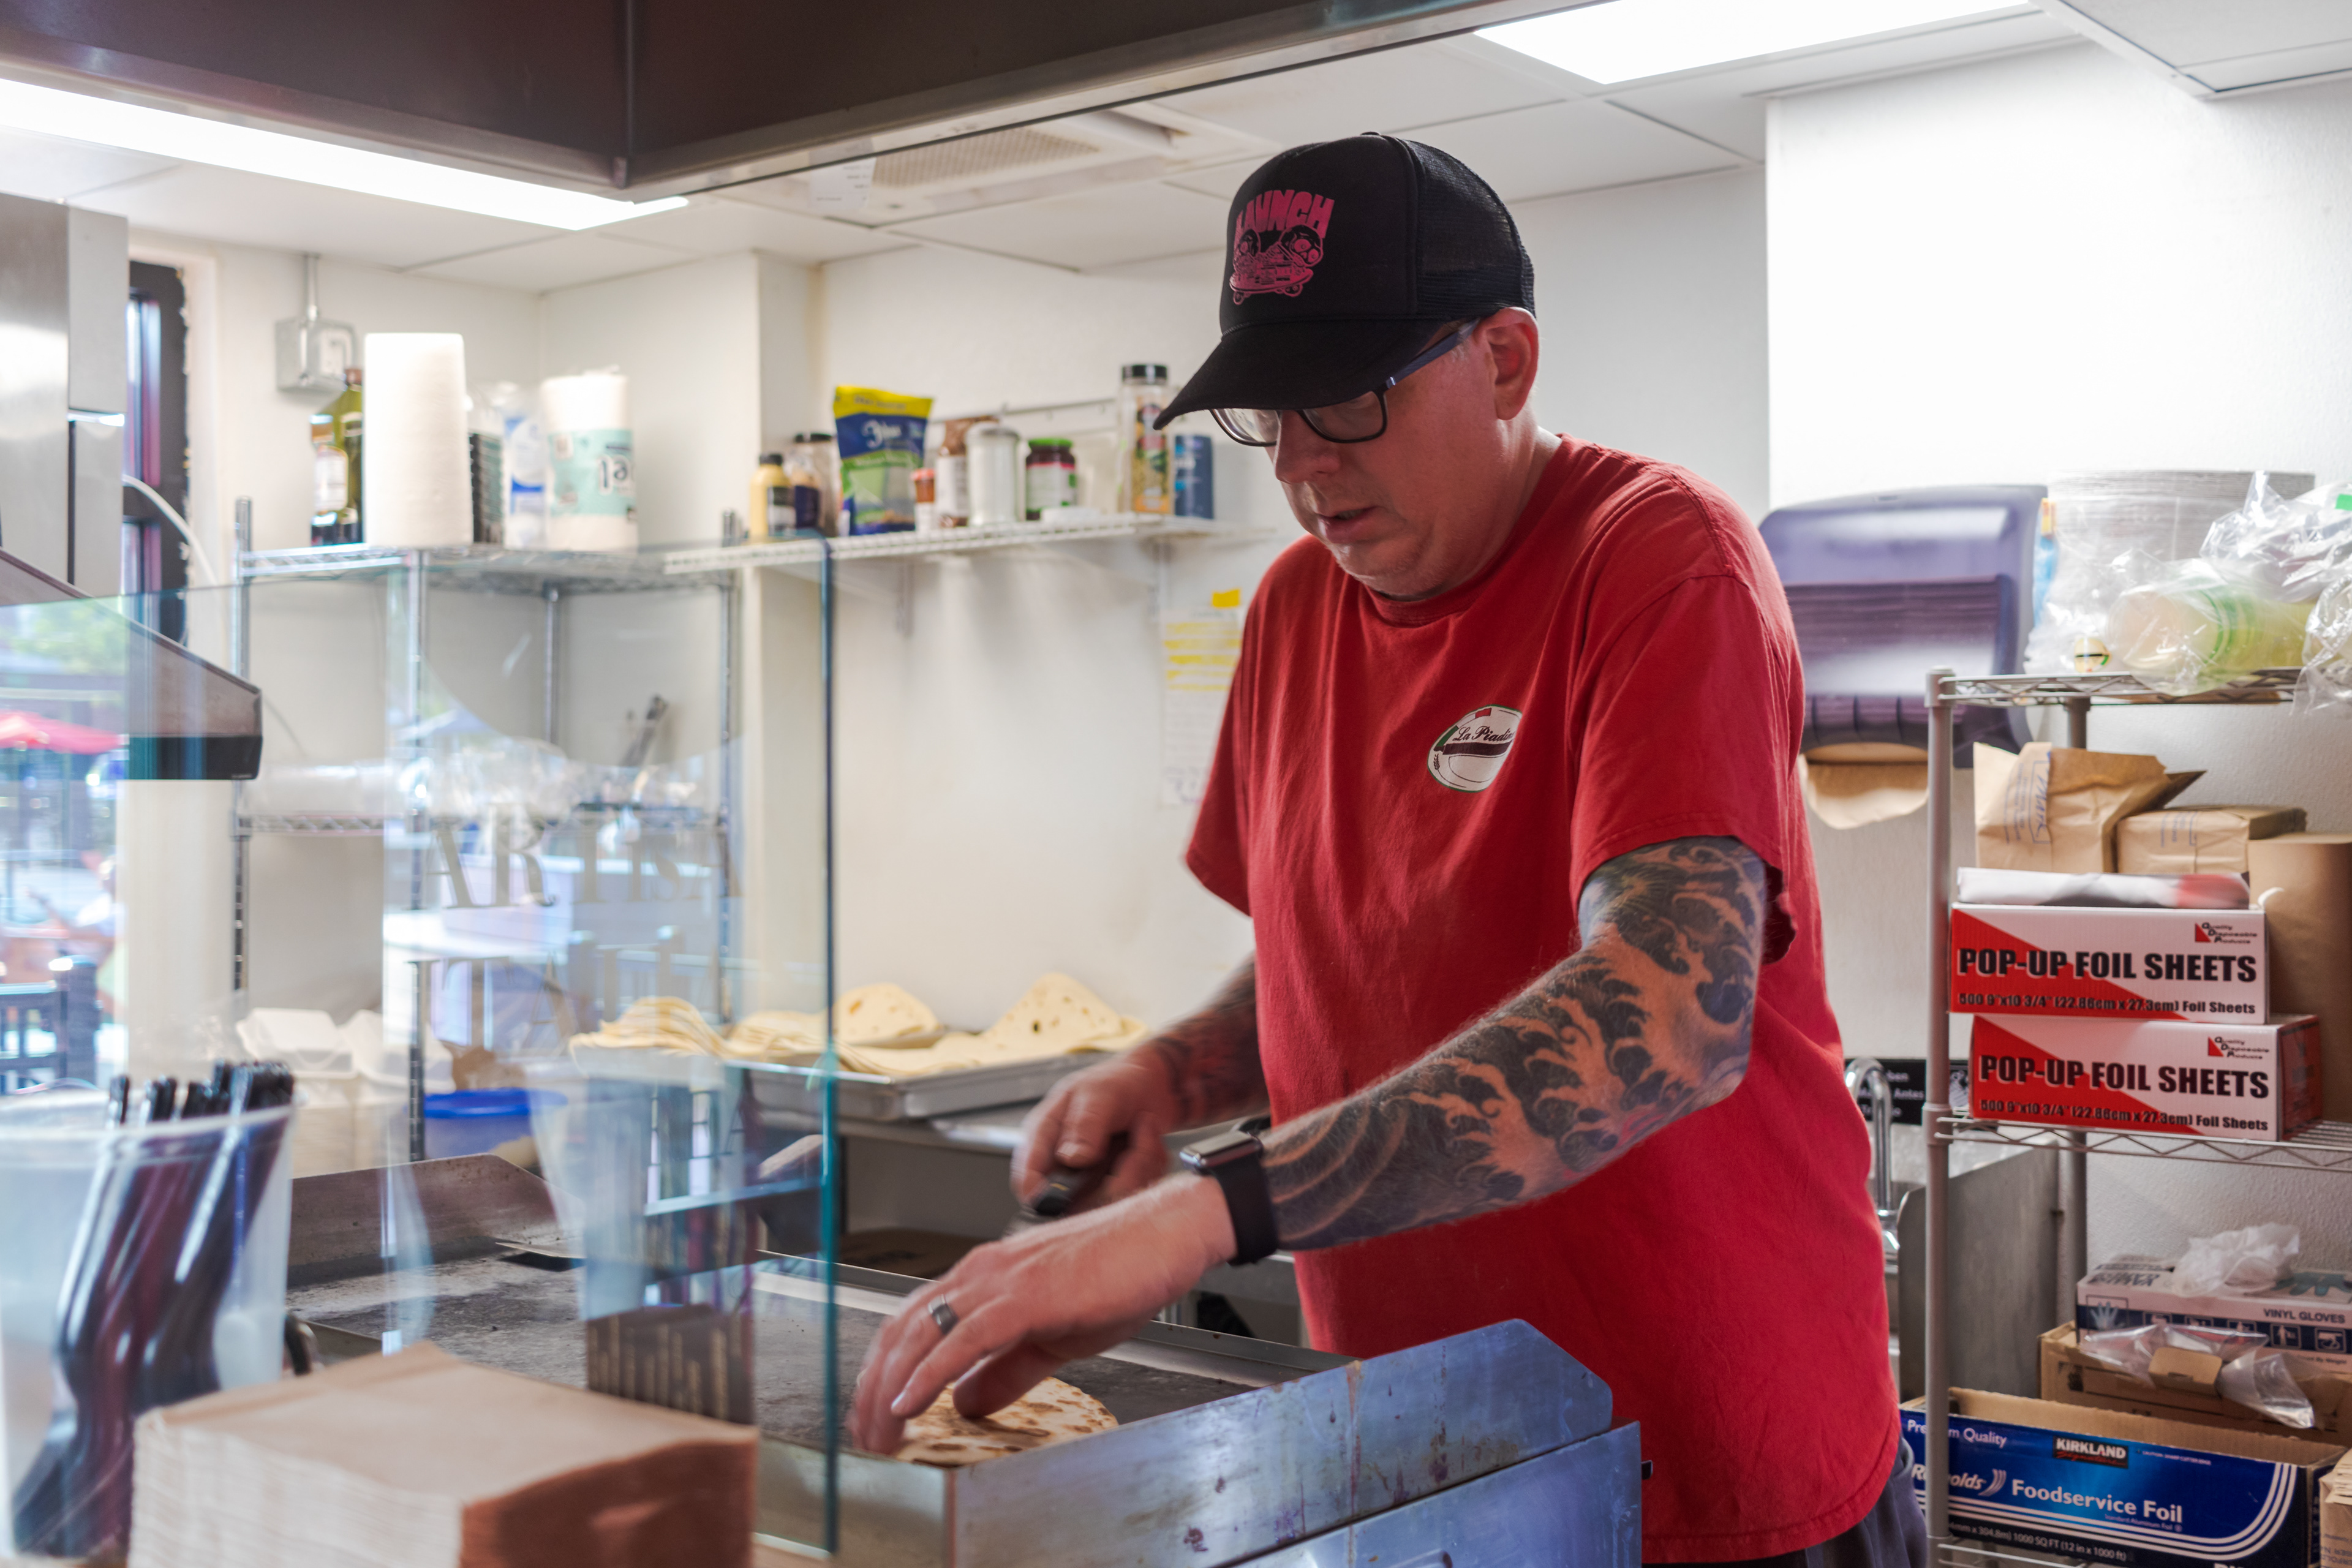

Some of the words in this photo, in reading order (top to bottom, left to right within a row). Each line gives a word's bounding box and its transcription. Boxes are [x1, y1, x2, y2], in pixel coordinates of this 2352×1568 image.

[1452, 726, 1471, 742] La
[1471, 725, 1515, 742] Piadi
[1958, 948, 2068, 978] POP-UP
[2073, 951, 2137, 979] FOIL
[2144, 952, 2257, 982] SHEETS
[1959, 993, 1984, 1005] 500
[2118, 1001, 2126, 1010] x
[2182, 1000, 2206, 1012] Foil
[2209, 1001, 2256, 1014] Sheets
[1978, 1055, 2084, 1088] POP-UP
[2090, 1061, 2151, 1091] FOIL
[2158, 1065, 2269, 1099] SHEETS
[1980, 1099, 2004, 1112] 500
[2133, 1113, 2140, 1122] x
[2196, 1115, 2219, 1128] Foil
[2222, 1117, 2268, 1131] Sheets
[2264, 1308, 2296, 1320] VINYL
[2299, 1311, 2345, 1324] GLOVES
[1907, 1419, 1960, 1438] Prem
[1963, 1427, 2007, 1449] Quality
[2056, 1437, 2127, 1460] KIRKLAND
[1911, 1463, 1987, 1490] Rolds
[2011, 1479, 2136, 1515] Foodservice
[2143, 1499, 2183, 1523] Foil
[2013, 1532, 2034, 1544] 1000
[2035, 1536, 2048, 1548] SQ
[2049, 1538, 2060, 1548] FT
[2076, 1543, 2085, 1553] in
[2094, 1547, 2114, 1559] 1000
